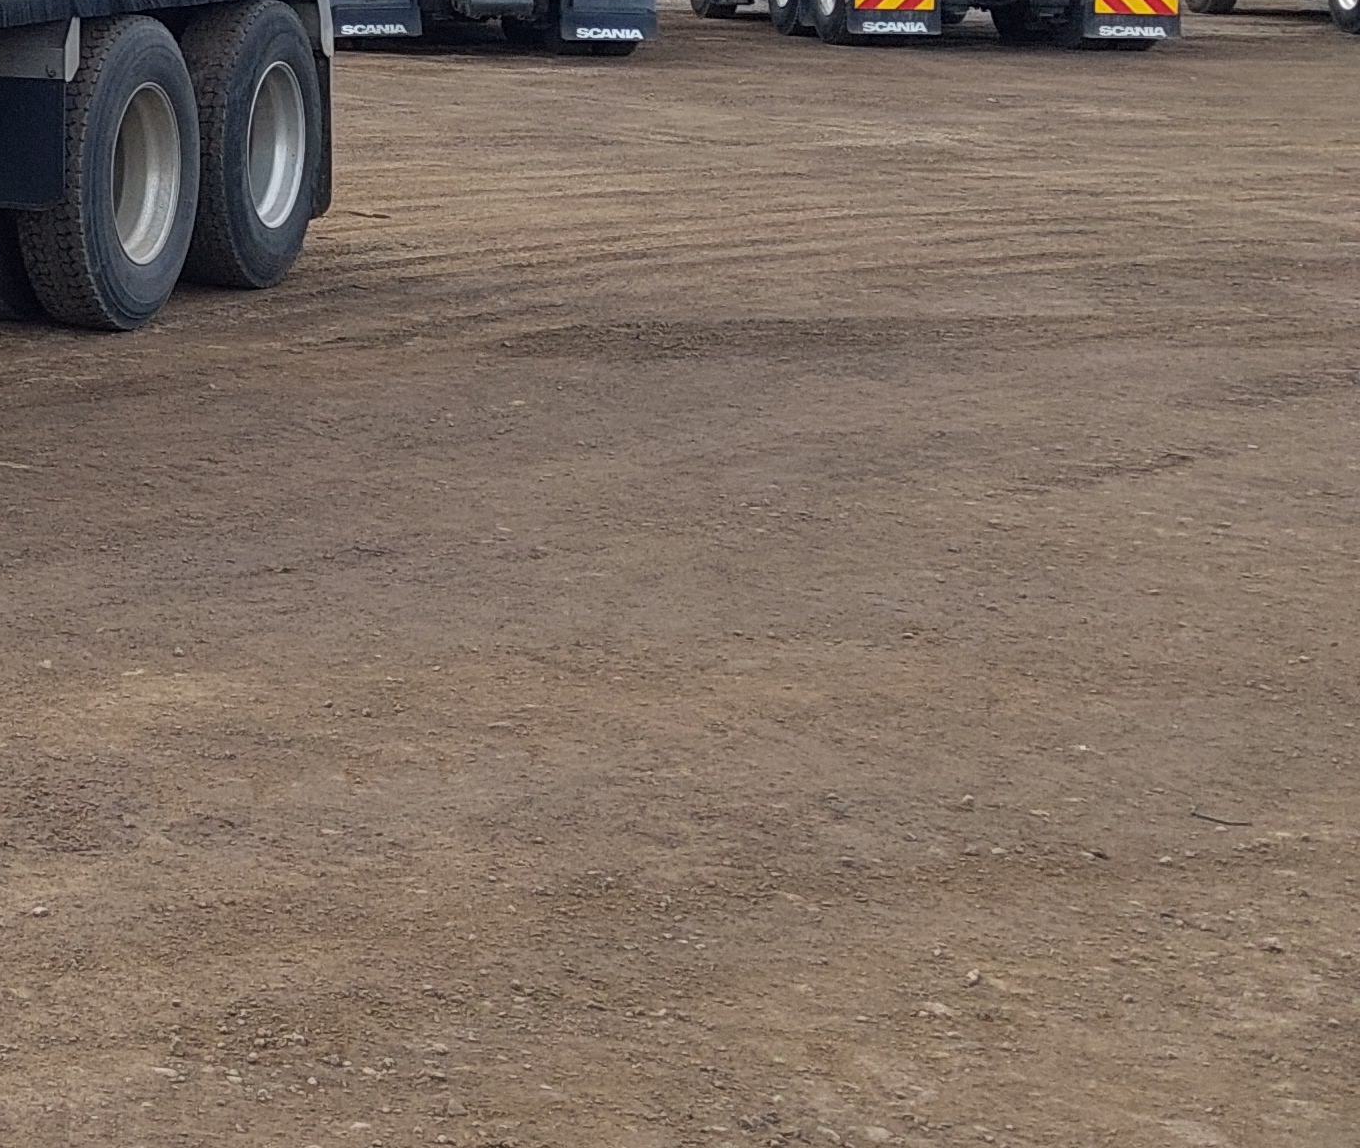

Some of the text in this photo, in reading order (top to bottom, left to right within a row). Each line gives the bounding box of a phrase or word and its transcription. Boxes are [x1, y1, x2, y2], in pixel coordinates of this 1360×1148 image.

[340, 23, 408, 35] SCANIA
[862, 21, 929, 33] SCANIA
[1098, 25, 1168, 38] SCANIA
[576, 27, 644, 40] SCANIA
